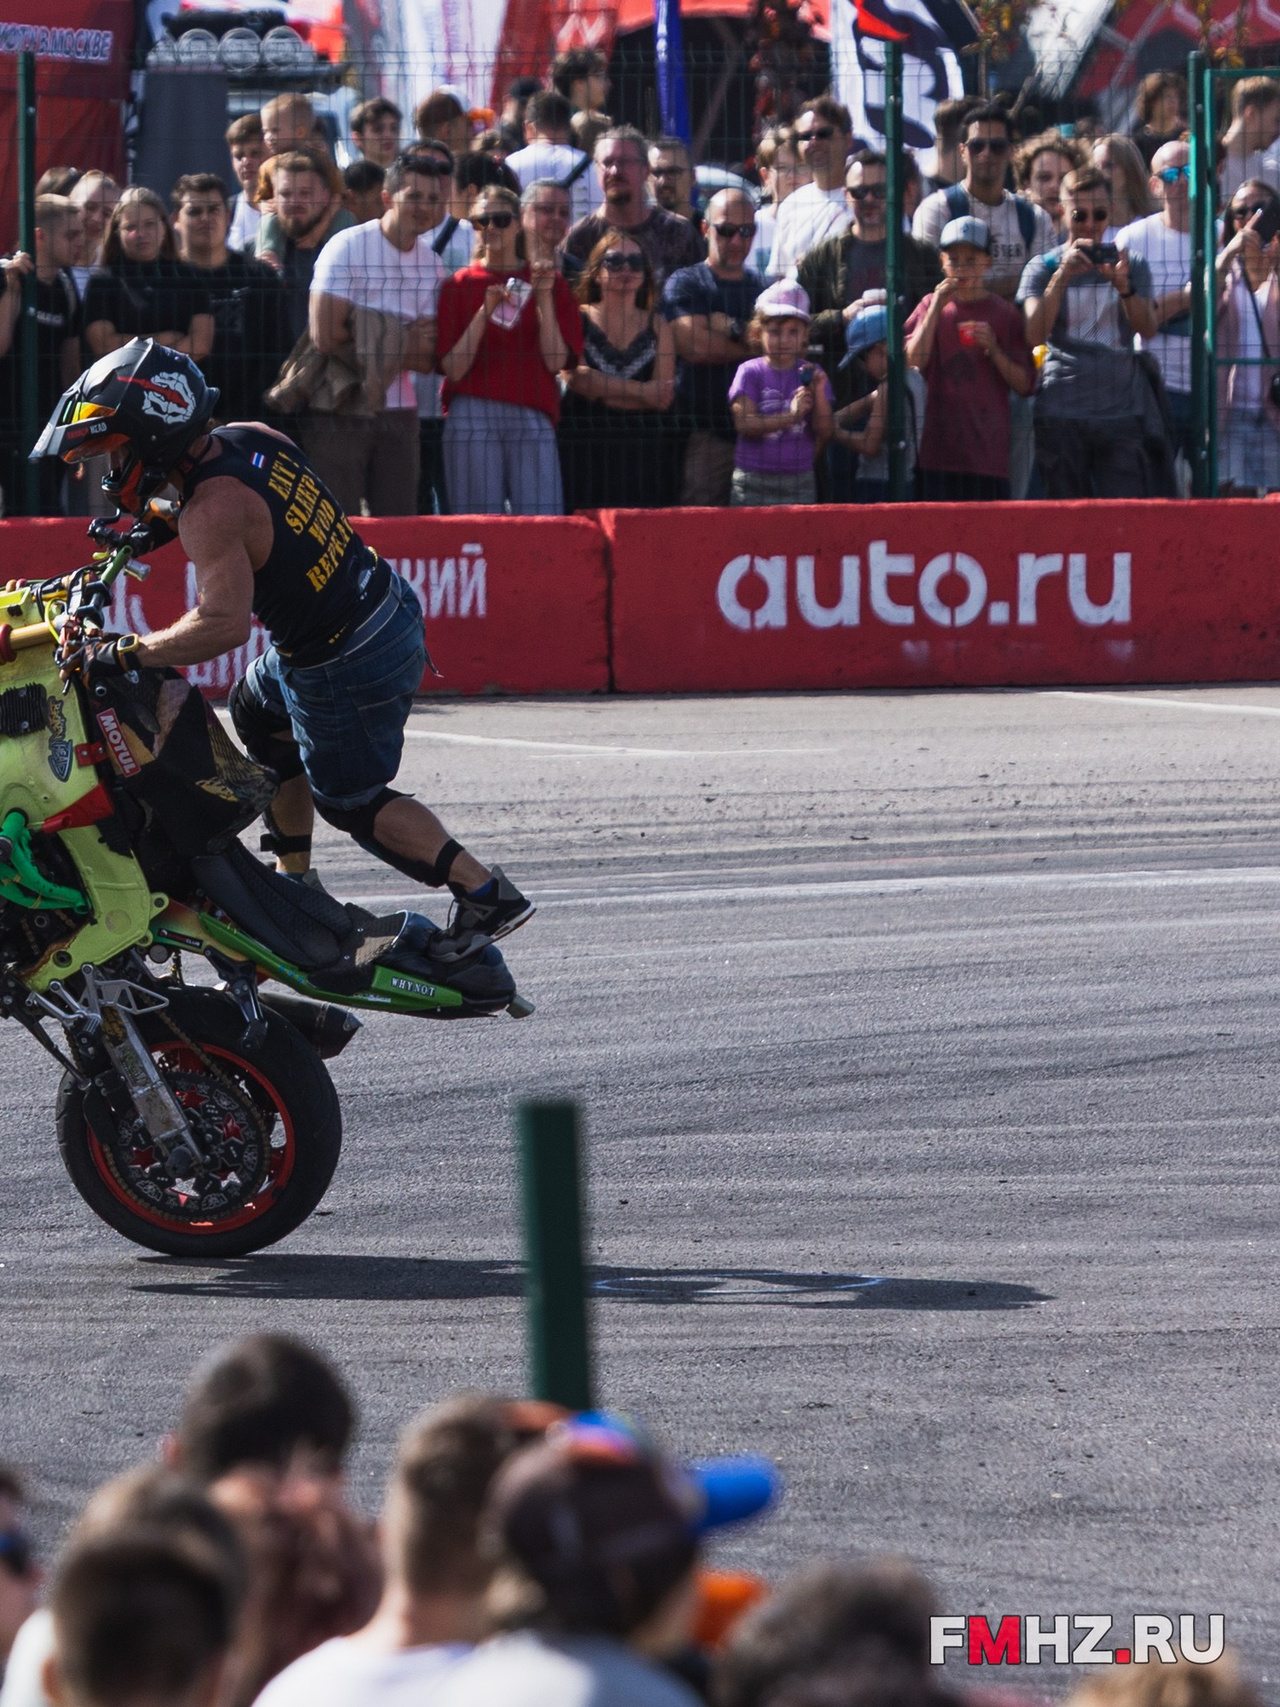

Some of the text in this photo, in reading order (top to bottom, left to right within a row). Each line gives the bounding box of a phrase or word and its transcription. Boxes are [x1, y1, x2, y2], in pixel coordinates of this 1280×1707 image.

[285, 474, 321, 535] SLEEP
[717, 540, 1133, 630] auto.ru
[100, 714, 137, 775] MOTUL
